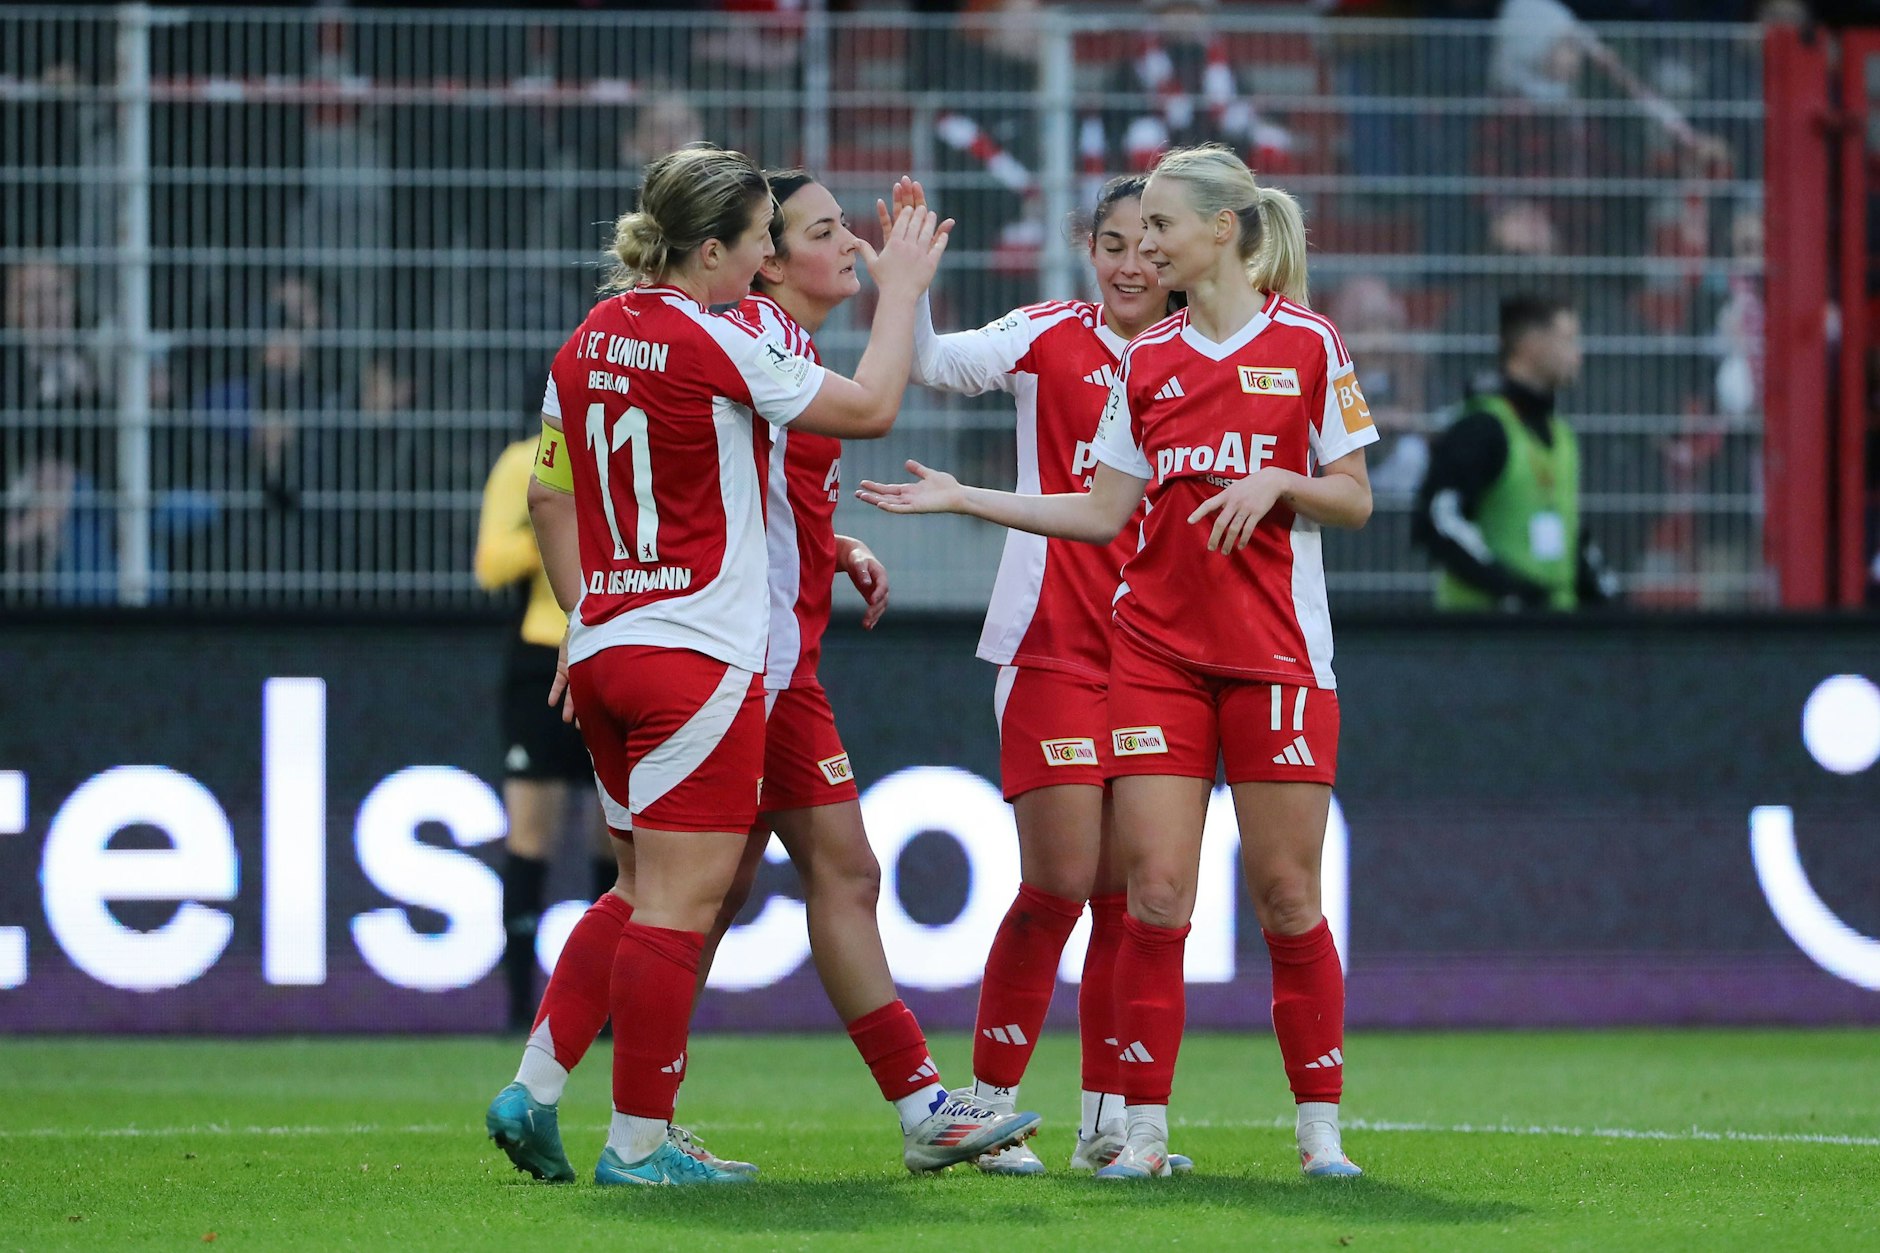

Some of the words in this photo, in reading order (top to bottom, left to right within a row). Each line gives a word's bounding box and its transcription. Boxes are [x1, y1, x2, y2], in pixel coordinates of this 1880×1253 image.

[586, 331, 605, 360] FC
[606, 334, 669, 373] UNION
[588, 371, 629, 395] BERLIN
[1273, 379, 1295, 389] UNION
[1157, 431, 1278, 485] proAF
[586, 403, 659, 562] 11
[1075, 748, 1094, 759] UNION
[1138, 736, 1160, 748] UNION
